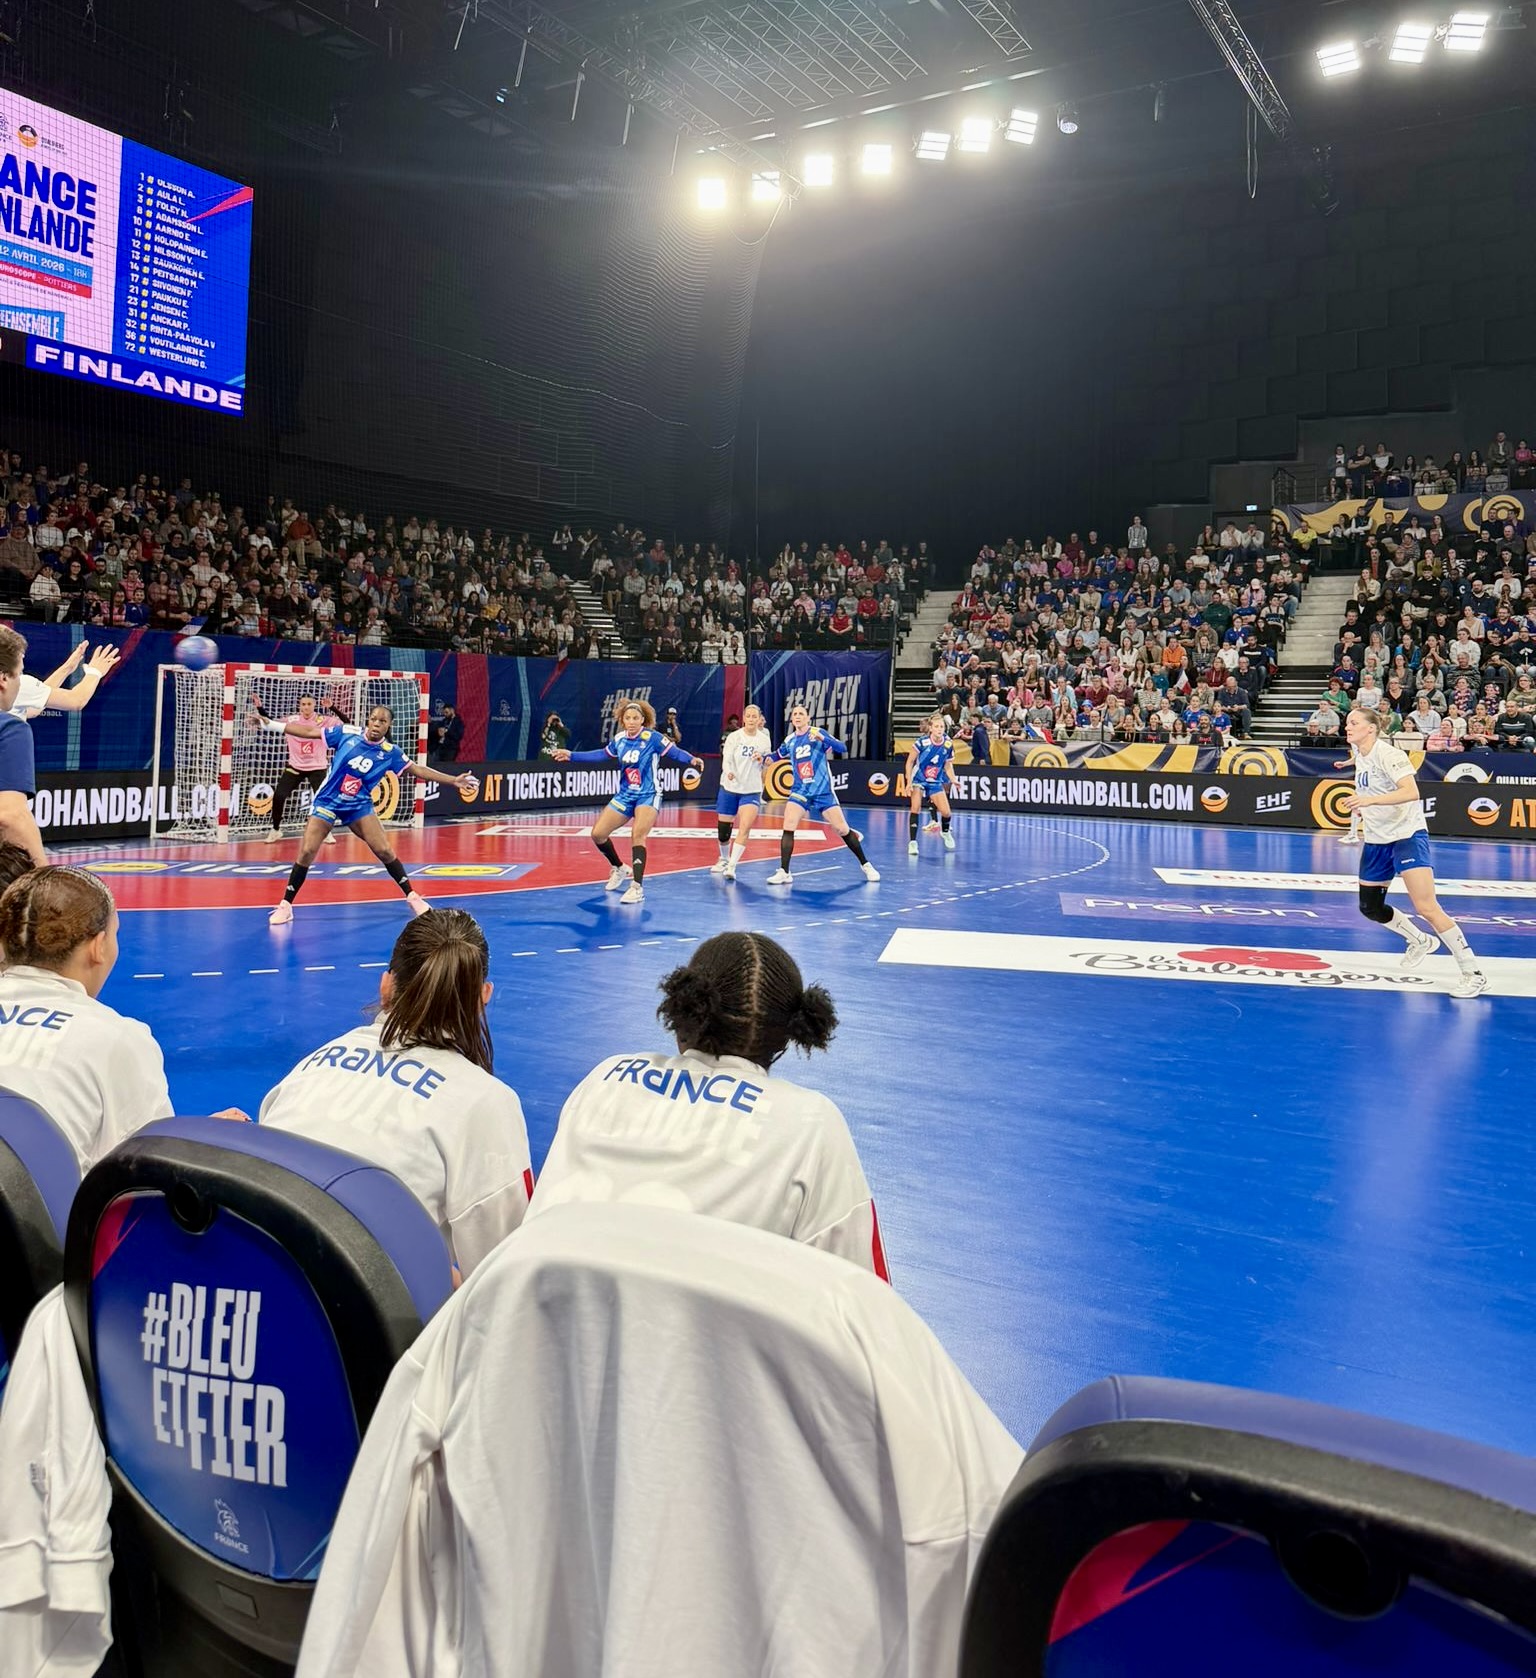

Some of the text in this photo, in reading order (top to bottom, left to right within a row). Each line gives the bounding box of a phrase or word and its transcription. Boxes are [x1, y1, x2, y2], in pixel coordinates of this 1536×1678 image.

[140, 172, 145, 181] 1
[137, 183, 144, 192] 2
[156, 189, 178, 203] AULA
[137, 193, 144, 203] 3
[156, 200, 181, 215] FOLEY
[133, 215, 143, 226] 10
[155, 223, 184, 239] AARNIO
[136, 205, 143, 214] 8
[155, 211, 197, 233] ADAMSSON
[131, 238, 141, 249] 12
[153, 245, 186, 262] NILSSON
[134, 227, 142, 237] 11
[154, 234, 201, 256] HOLOPAINEN
[12, 249, 39, 265] AVRIL
[41, 258, 65, 272] 2026
[131, 249, 141, 260] 13
[153, 256, 198, 278] SAUKKONEN
[129, 261, 140, 271] 14
[152, 267, 190, 286] PEITSARO
[130, 272, 140, 283] 17
[152, 279, 187, 297] SIIVONEN
[127, 295, 139, 306] 23
[150, 302, 181, 317] JENSEN
[129, 284, 139, 295] 21
[151, 290, 182, 306] PAUKKU
[128, 307, 138, 318] 31
[150, 313, 182, 329] ANCKAR
[125, 318, 137, 329] 32
[150, 324, 210, 347] RINTA-PAAVOLA
[125, 329, 136, 341] 36
[149, 335, 199, 356] VOUTILAINEN
[124, 341, 136, 352] 72
[149, 346, 200, 367] WESTERLUND
[35, 344, 242, 410] FINLANDE
[622, 750, 640, 764] 48
[795, 744, 812, 760] 22
[930, 754, 940, 765] 4
[347, 755, 374, 774] 49
[484, 774, 503, 802] AT
[832, 772, 849, 786] HF
[1256, 790, 1292, 809] EHF
[1510, 798, 1536, 828] AT
[1069, 951, 1434, 985] Boulangère
[1148, 953, 1184, 966] la
[0, 1003, 74, 1030] NCE
[140, 1282, 262, 1381] #BLEU
[152, 1366, 288, 1488] ETFIER
